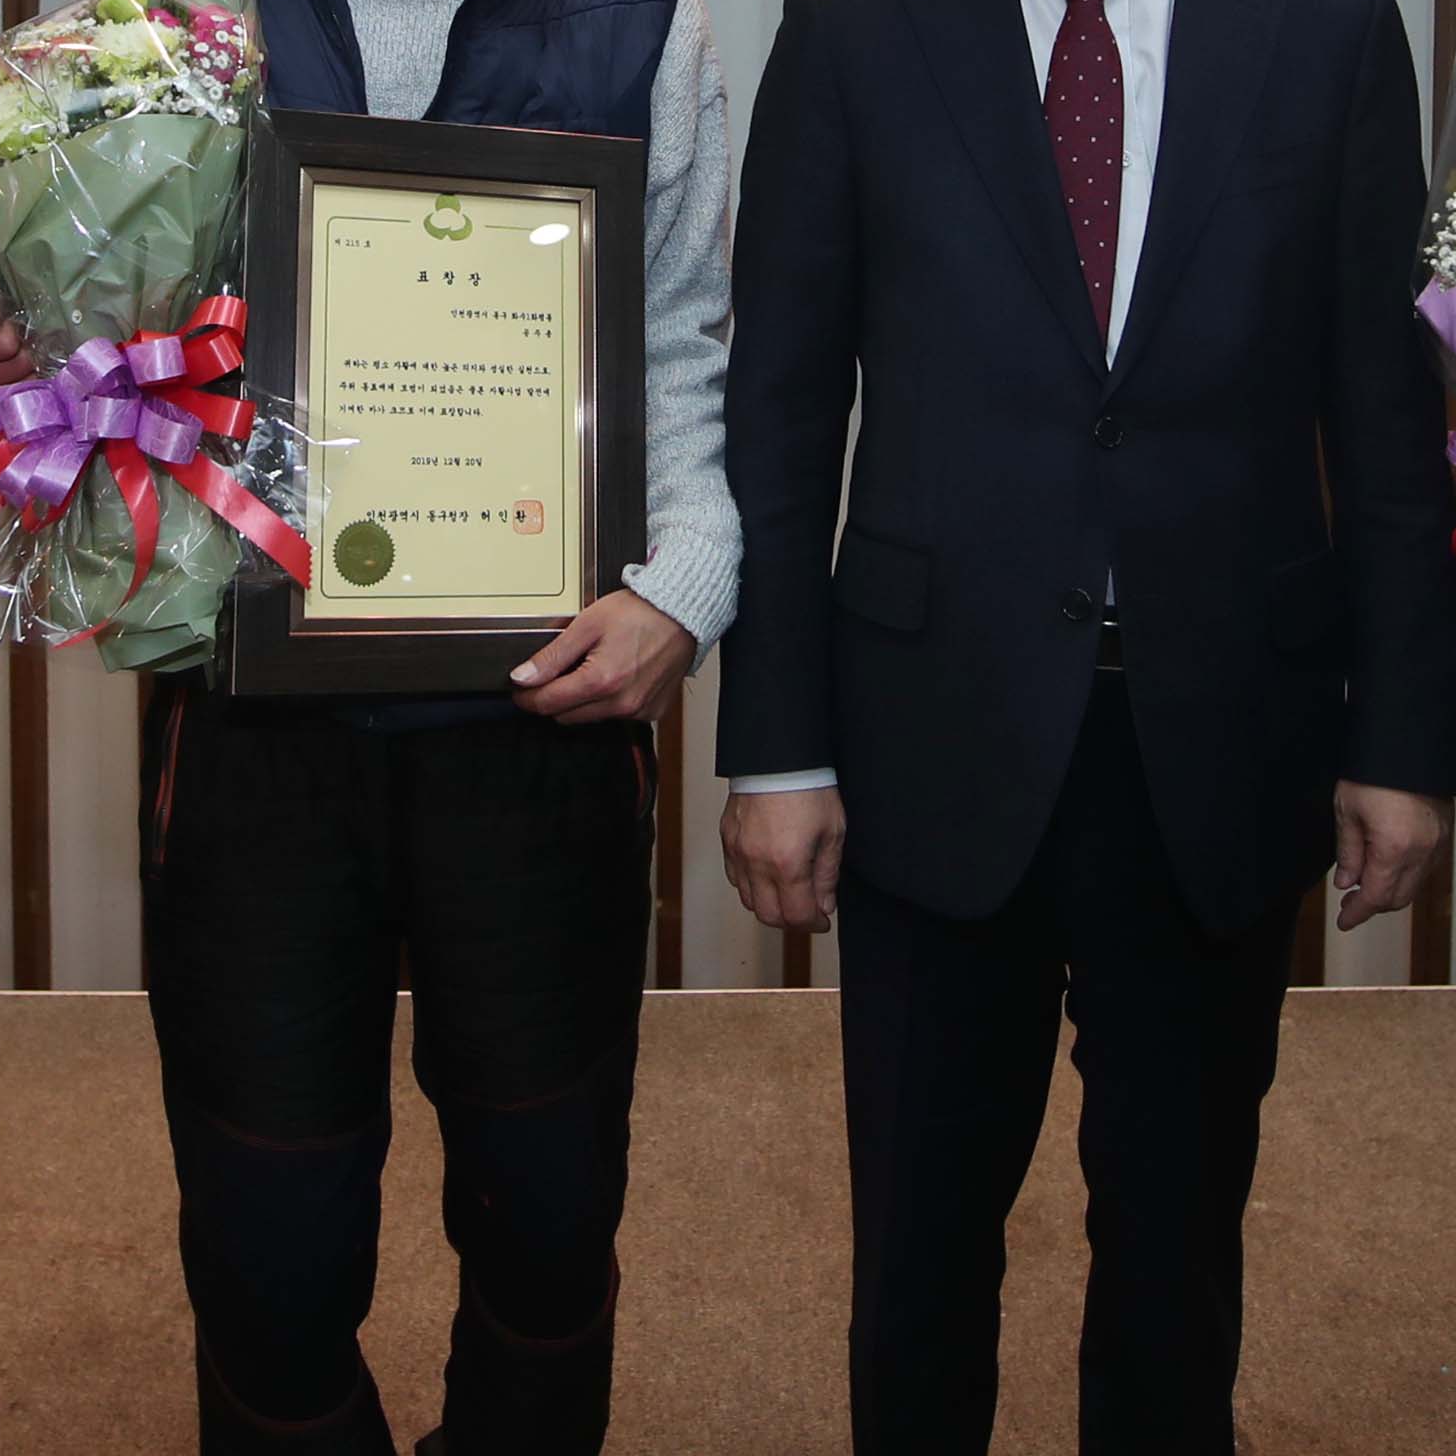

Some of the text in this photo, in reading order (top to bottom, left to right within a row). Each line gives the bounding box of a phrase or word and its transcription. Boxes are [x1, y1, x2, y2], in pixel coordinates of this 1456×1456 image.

[417, 271, 481, 286] 표 창 장
